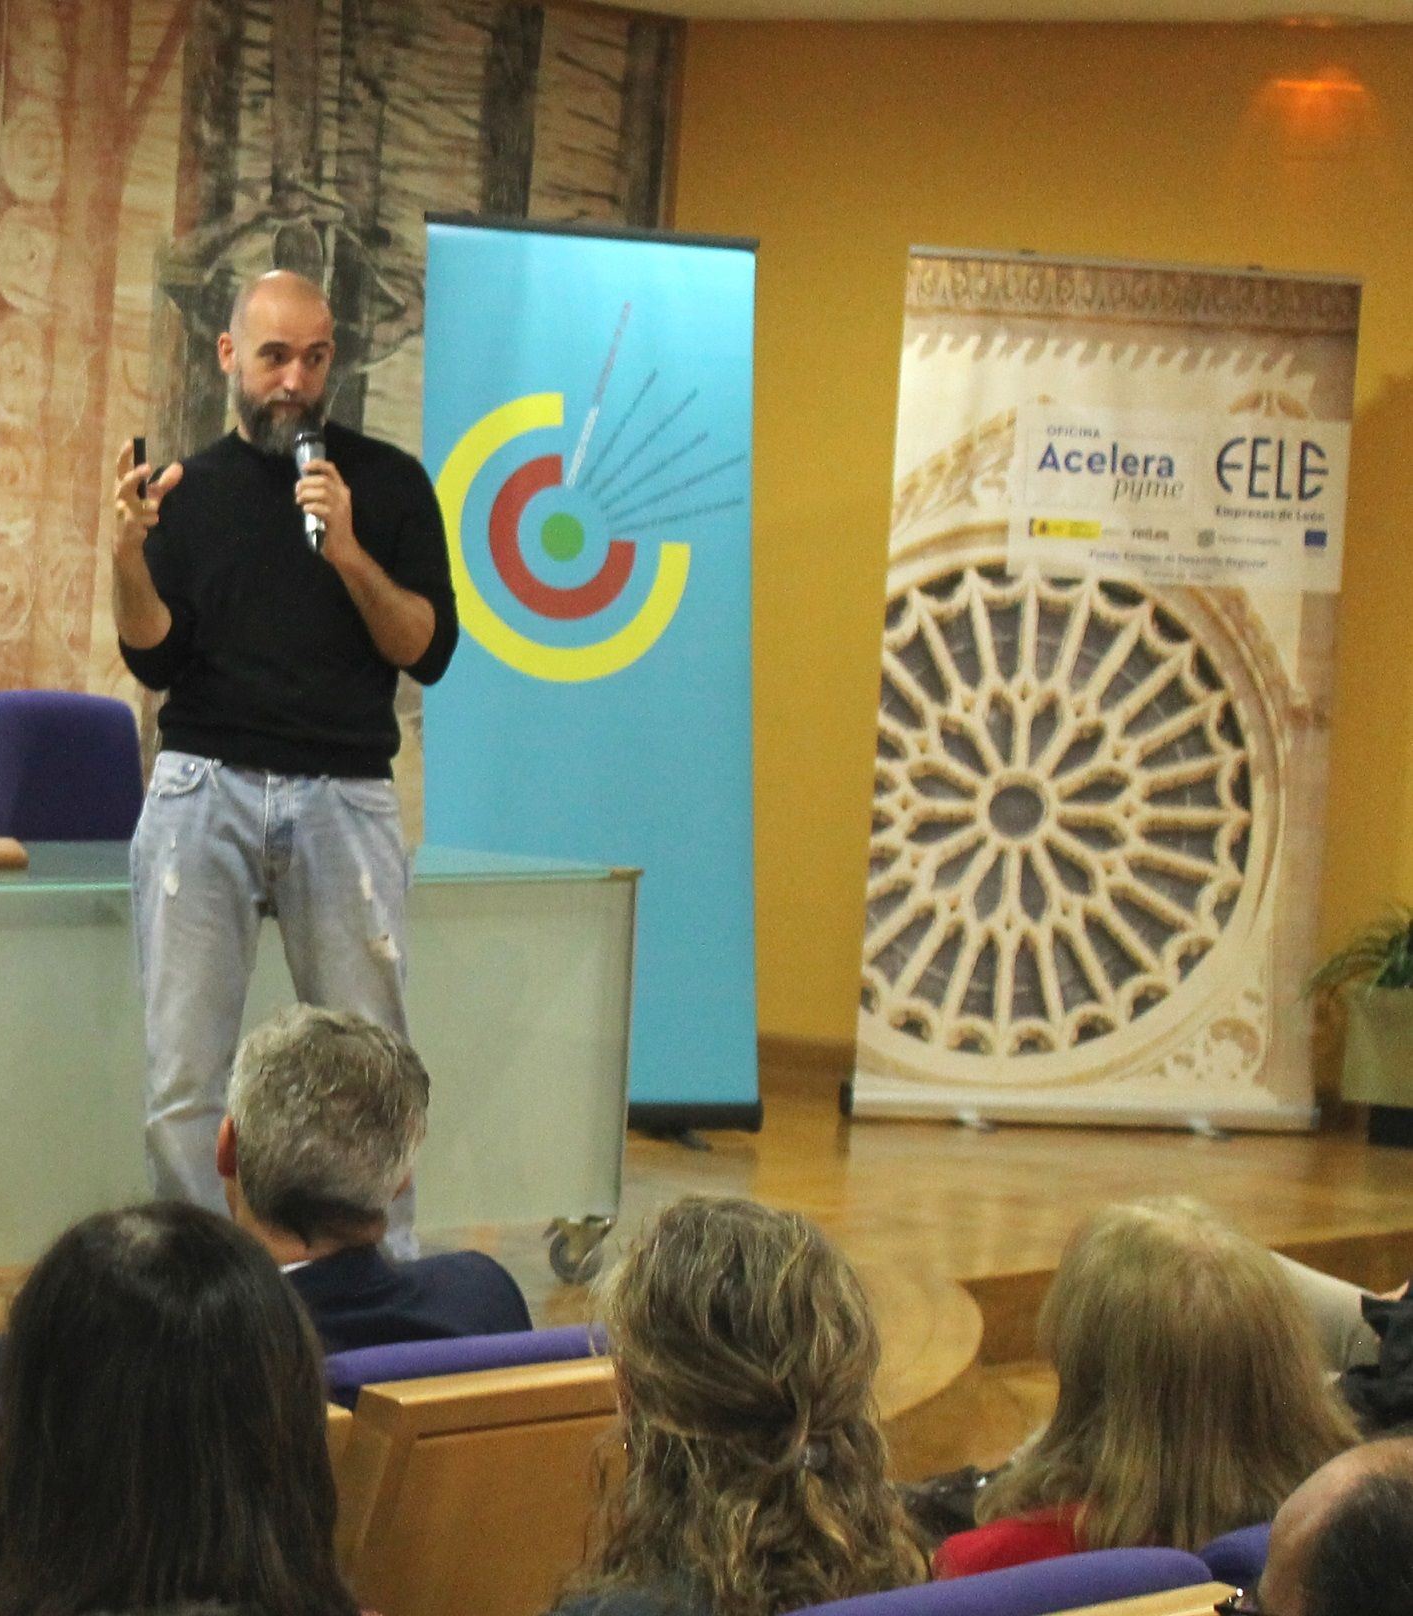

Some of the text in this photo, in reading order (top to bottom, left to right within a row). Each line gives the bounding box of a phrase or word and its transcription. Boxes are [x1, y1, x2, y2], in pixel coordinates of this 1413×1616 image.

[1046, 424, 1101, 439] OFICINA
[1037, 442, 1176, 479] Acelera
[1112, 477, 1185, 504] pyme
[1215, 504, 1275, 520] Empresas
[1279, 507, 1293, 519] de
